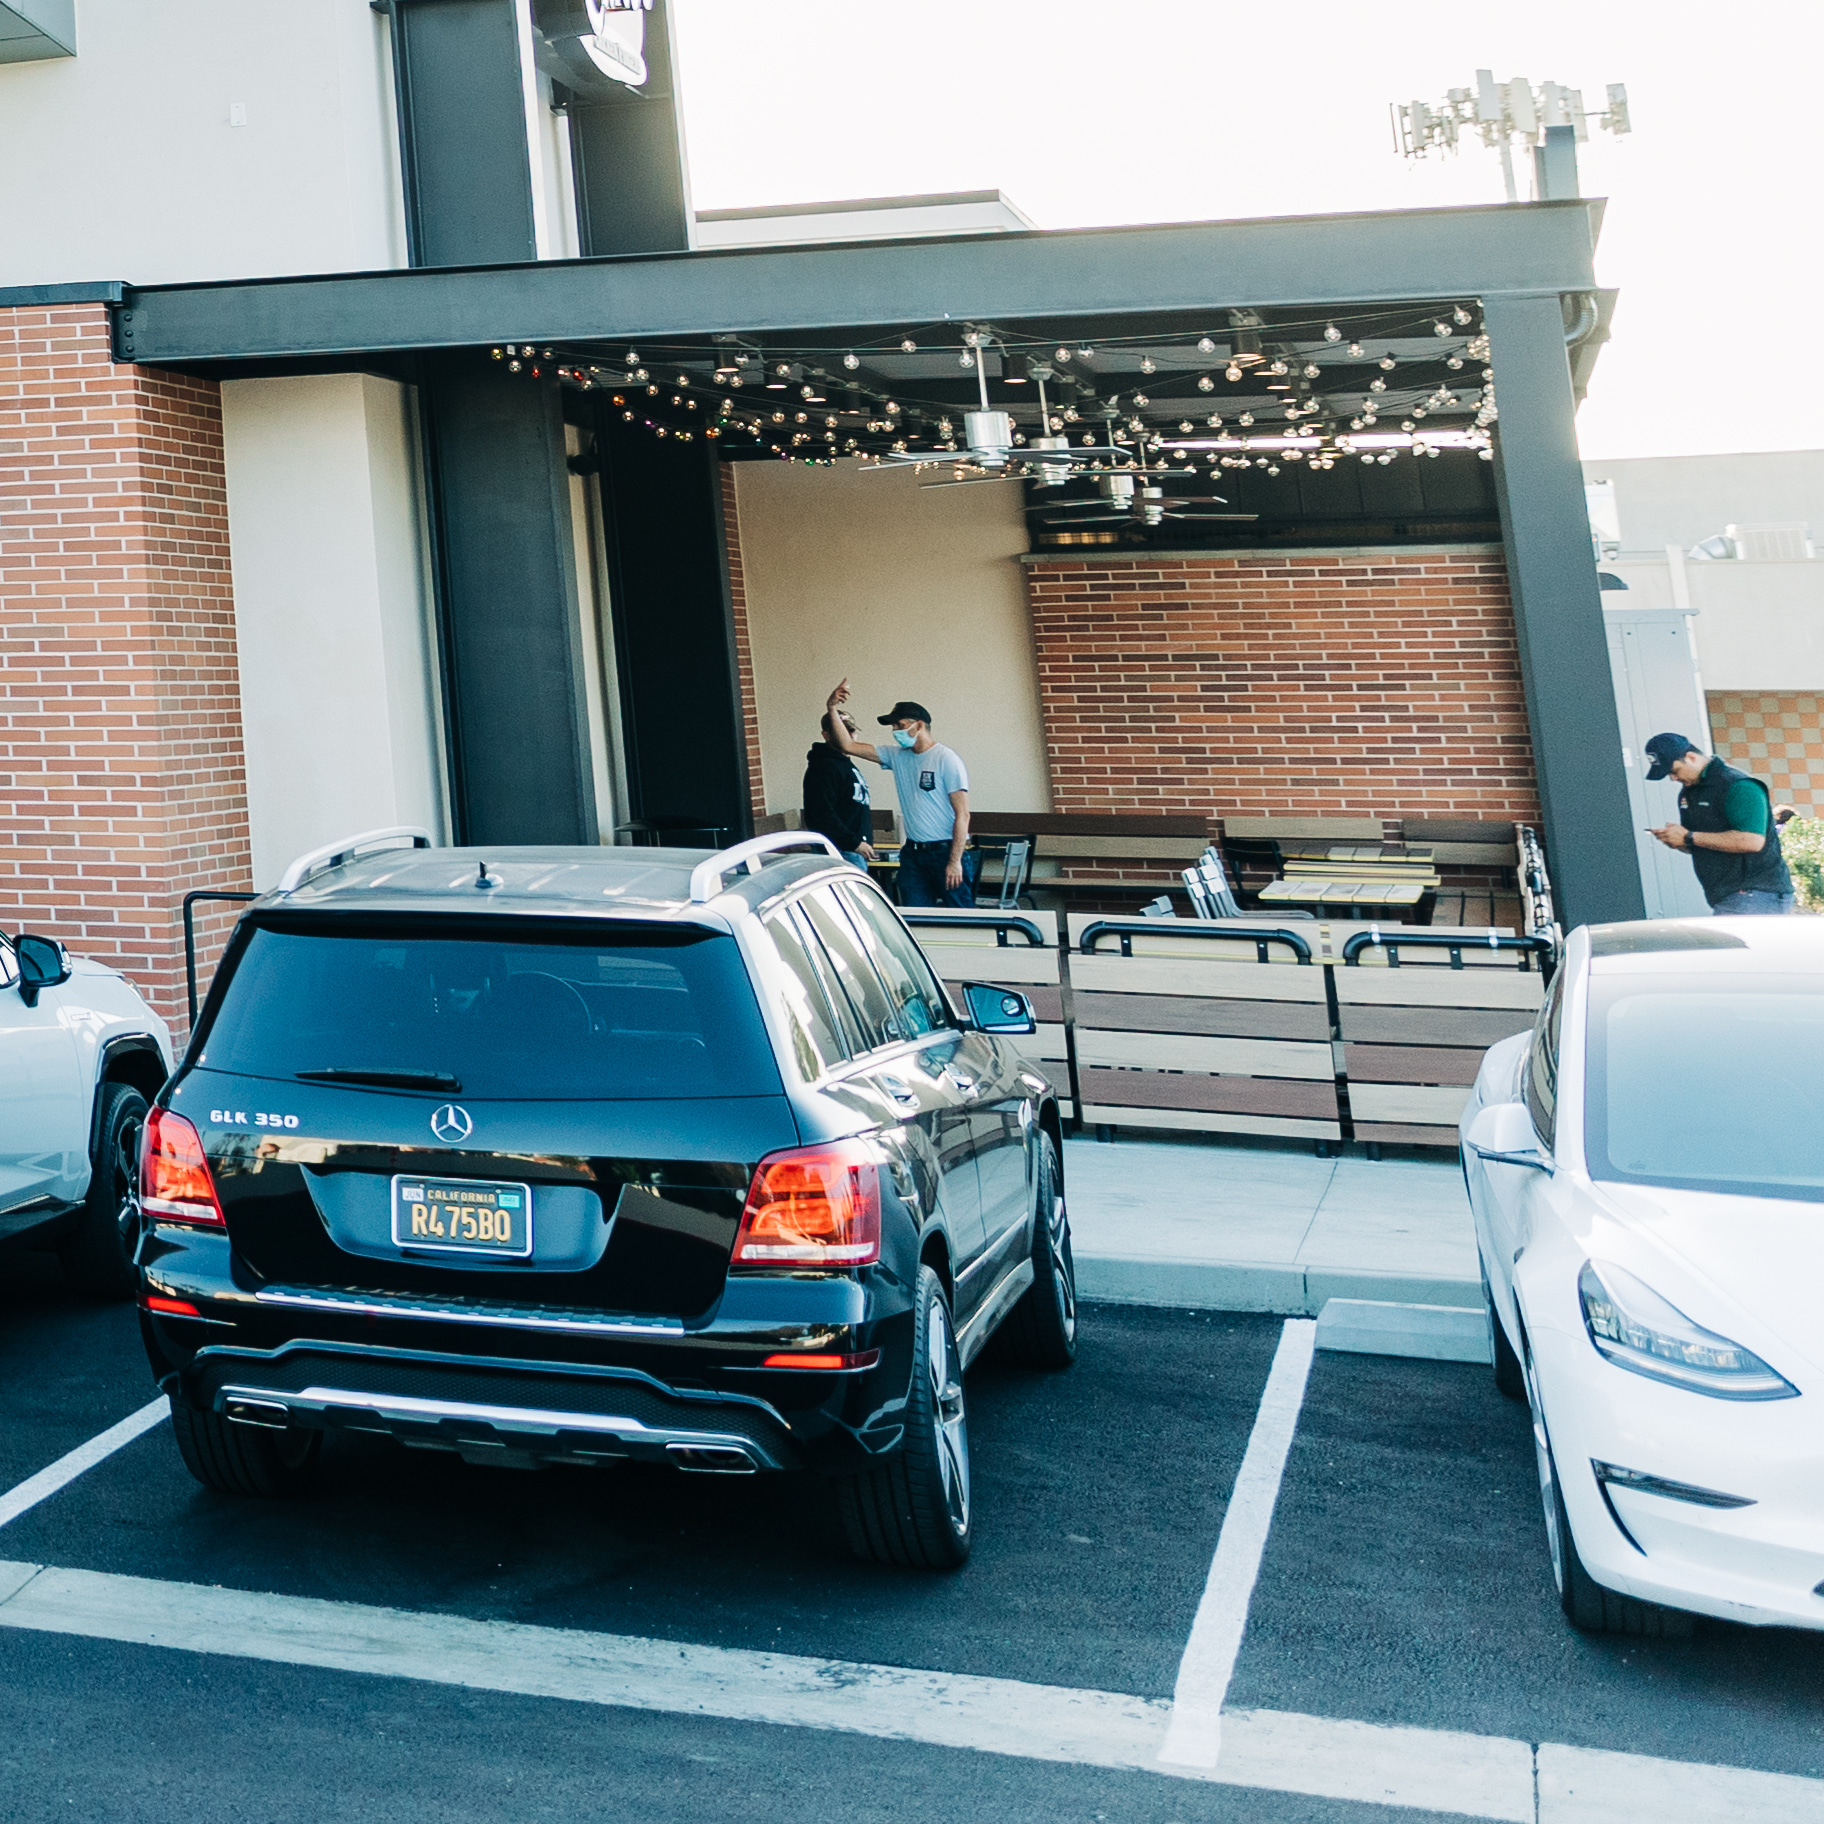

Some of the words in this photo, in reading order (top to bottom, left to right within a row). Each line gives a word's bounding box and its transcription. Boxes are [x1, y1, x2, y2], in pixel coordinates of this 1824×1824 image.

[210, 1109, 248, 1125] GLK
[254, 1112, 299, 1128] 350
[427, 1189, 496, 1204] CALIFORNIA
